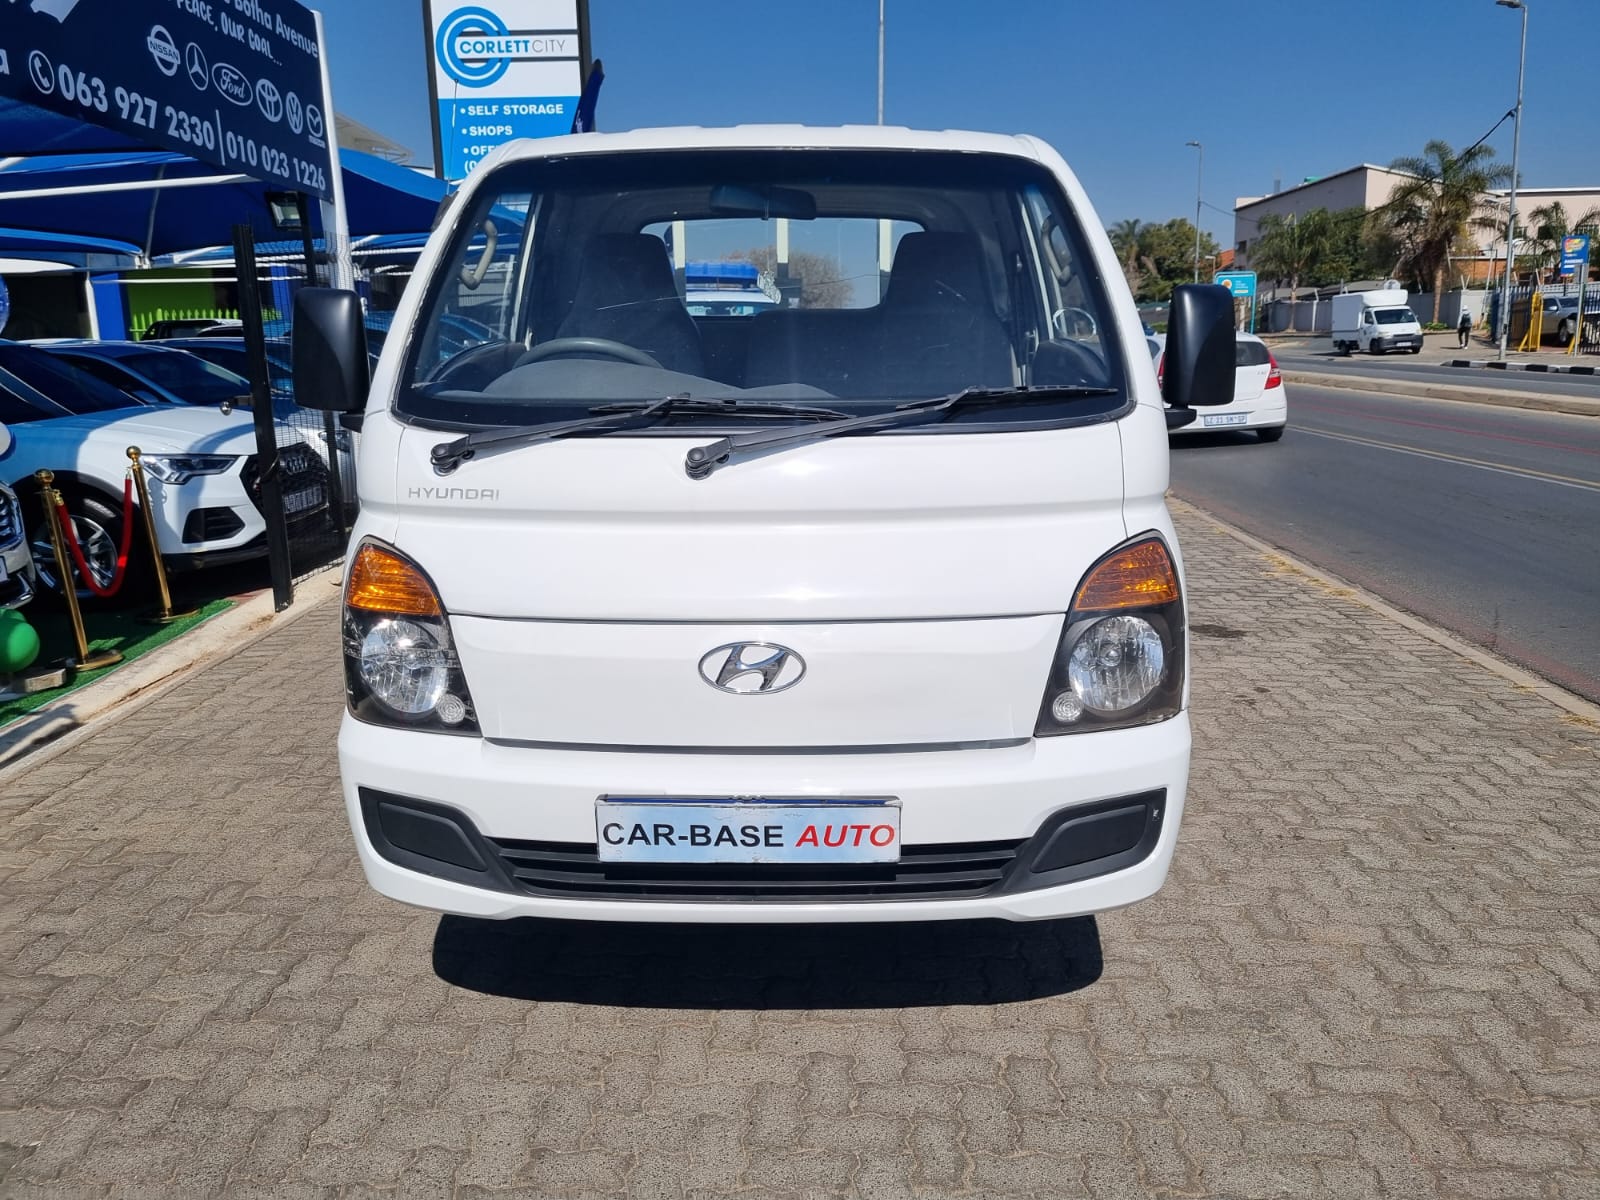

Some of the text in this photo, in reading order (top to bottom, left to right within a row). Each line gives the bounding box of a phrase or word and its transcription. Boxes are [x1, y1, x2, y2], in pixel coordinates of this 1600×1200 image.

[220, 12, 245, 44] OUR
[276, 13, 318, 58] Avenue
[150, 39, 179, 61] NISSAN
[219, 68, 246, 99] Ford
[468, 104, 564, 116] SELF STORAGE
[58, 63, 326, 192] 063 927 2330 010 023 1226
[469, 126, 513, 136] SHOPS
[471, 145, 497, 156] OFF
[408, 487, 500, 500] HYUNDAI
[602, 822, 896, 848] CAR-BASE AUTO
